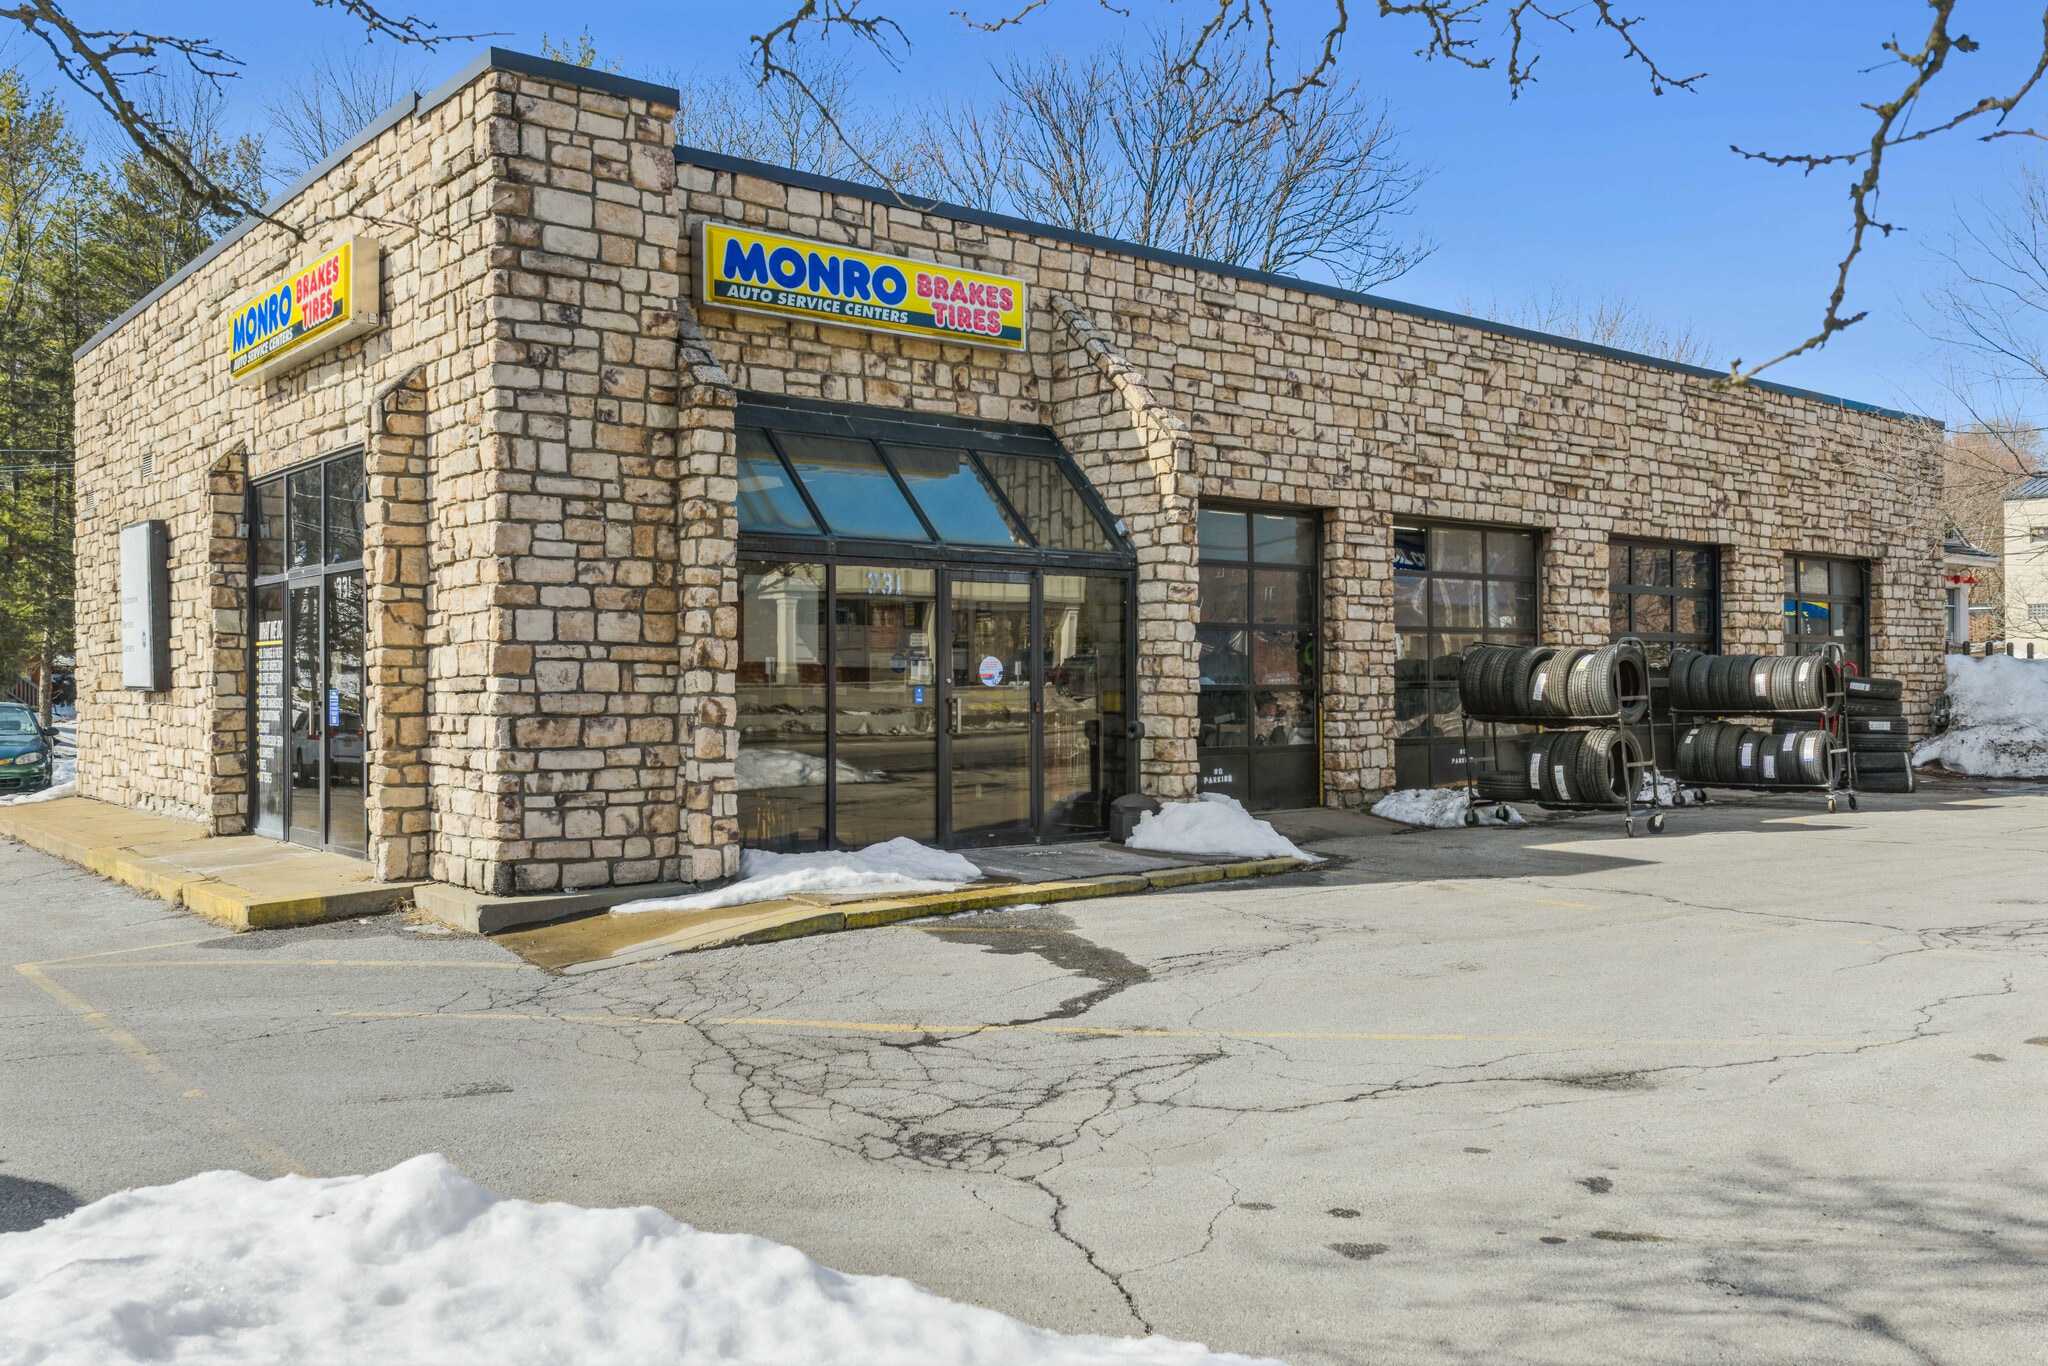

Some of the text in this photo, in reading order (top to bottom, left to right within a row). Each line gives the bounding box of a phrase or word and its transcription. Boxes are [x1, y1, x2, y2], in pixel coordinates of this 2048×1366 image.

[296, 255, 339, 304] BRAKES
[722, 238, 908, 306] MONRO
[302, 288, 334, 330] TIRES
[727, 284, 908, 323] AUTO SERVICE CENTERS
[916, 273, 1013, 311] BRAKES
[233, 285, 292, 355] MONRO
[931, 301, 1001, 334] TIRES
[233, 327, 293, 371] AUTO SERVICE CENTERS
[866, 572, 902, 595] 331
[1203, 774, 1233, 784] PARKING
[1213, 767, 1223, 775] NO
